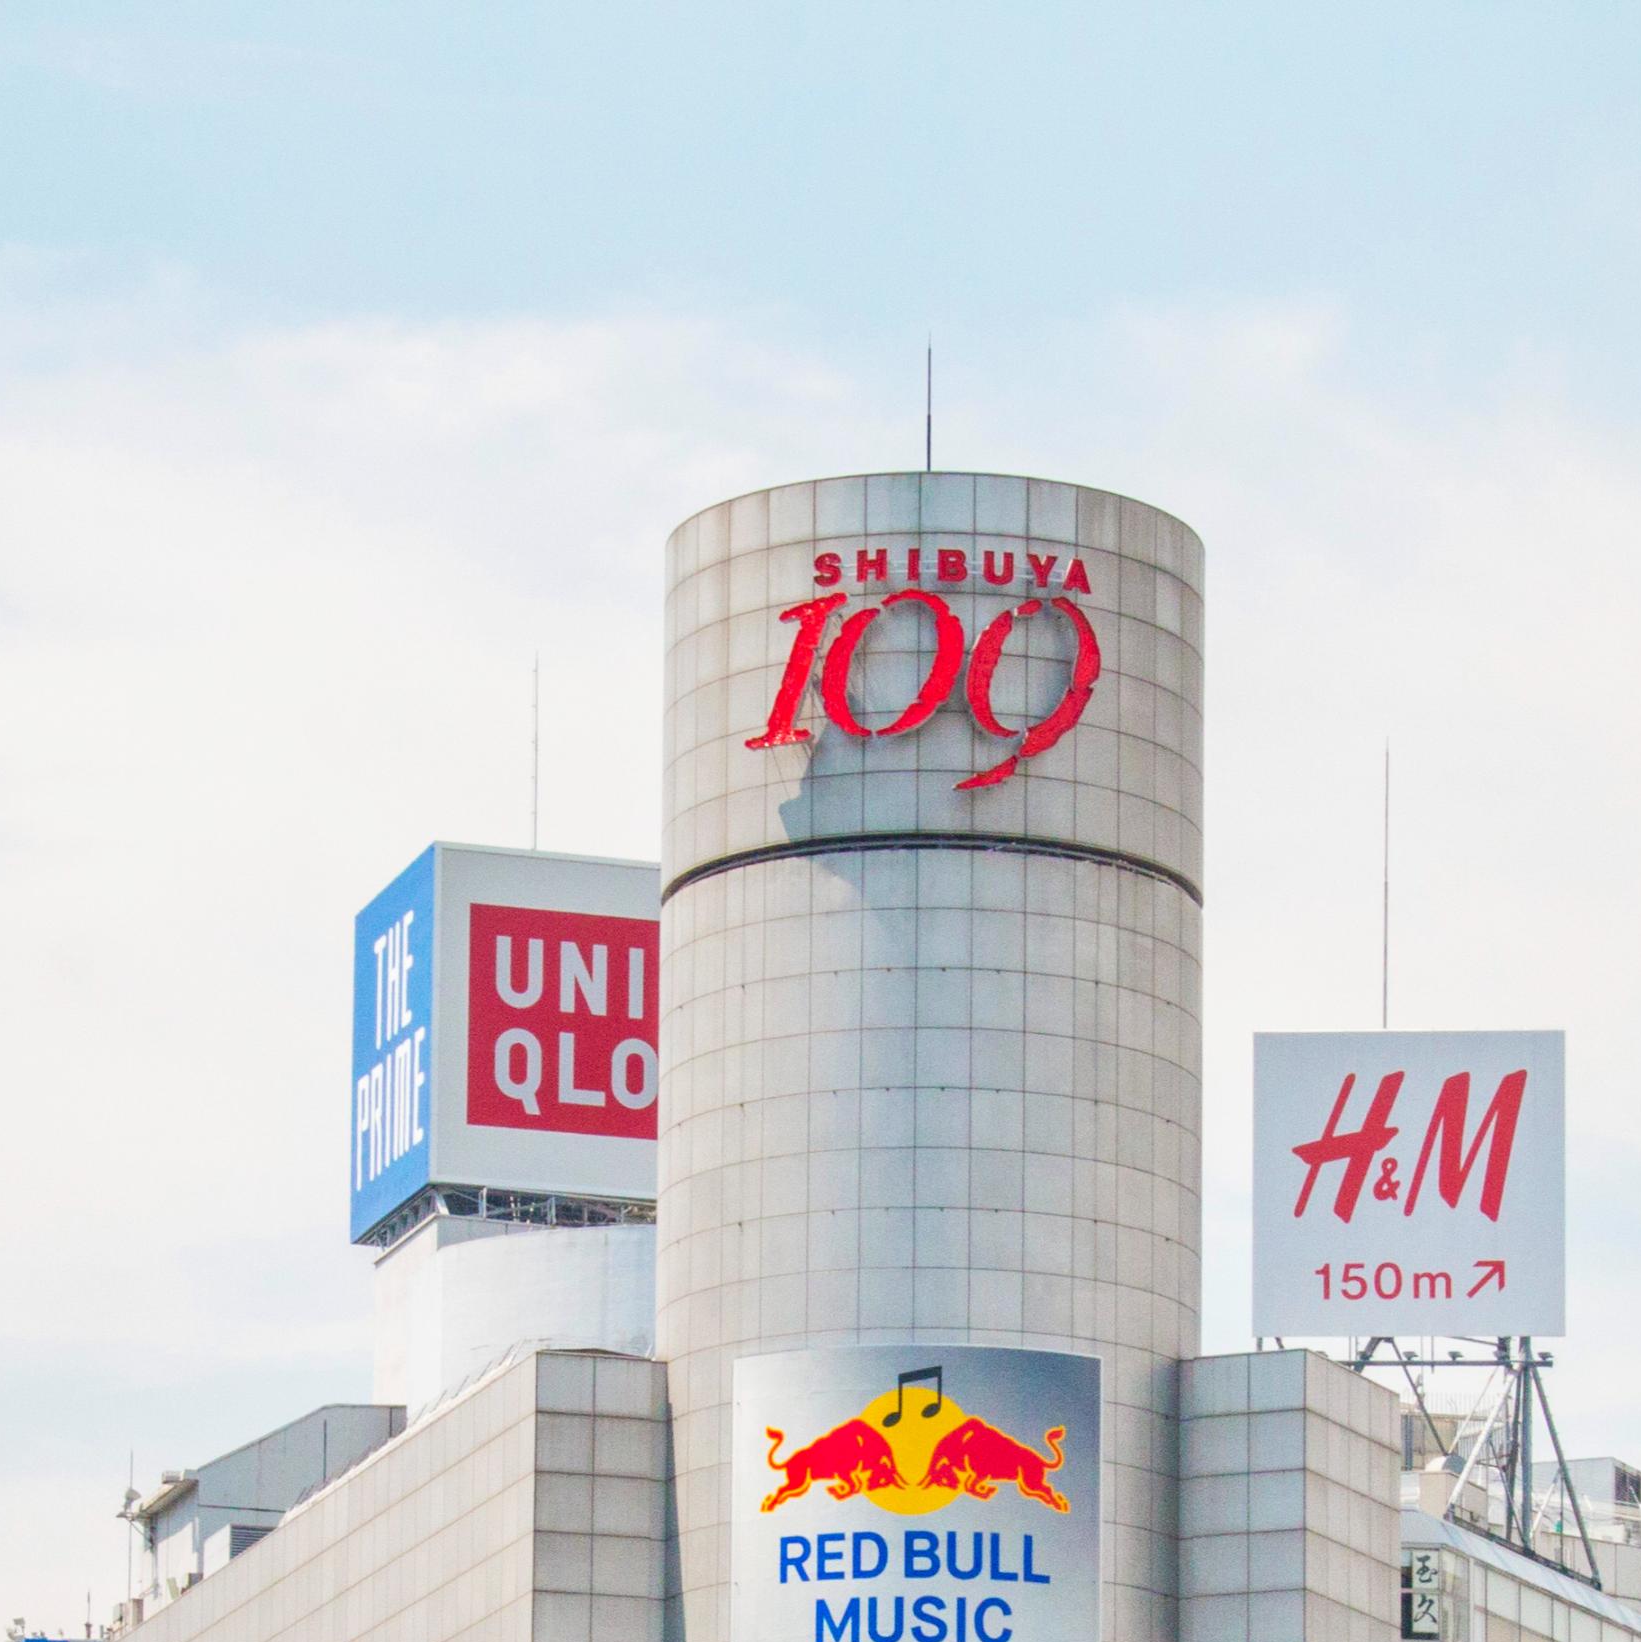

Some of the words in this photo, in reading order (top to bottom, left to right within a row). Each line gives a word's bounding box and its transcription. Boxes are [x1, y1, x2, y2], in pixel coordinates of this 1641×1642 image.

[814, 547, 1092, 596] SHIBUYA
[744, 588, 1102, 791] 109
[373, 910, 415, 1050] THE
[495, 935, 645, 1020] UNI
[355, 1026, 426, 1192] PRIME
[494, 1027, 658, 1116] QLO
[1291, 1069, 1528, 1224] H&M
[779, 1532, 889, 1584] RED
[905, 1530, 1050, 1584] BULL
